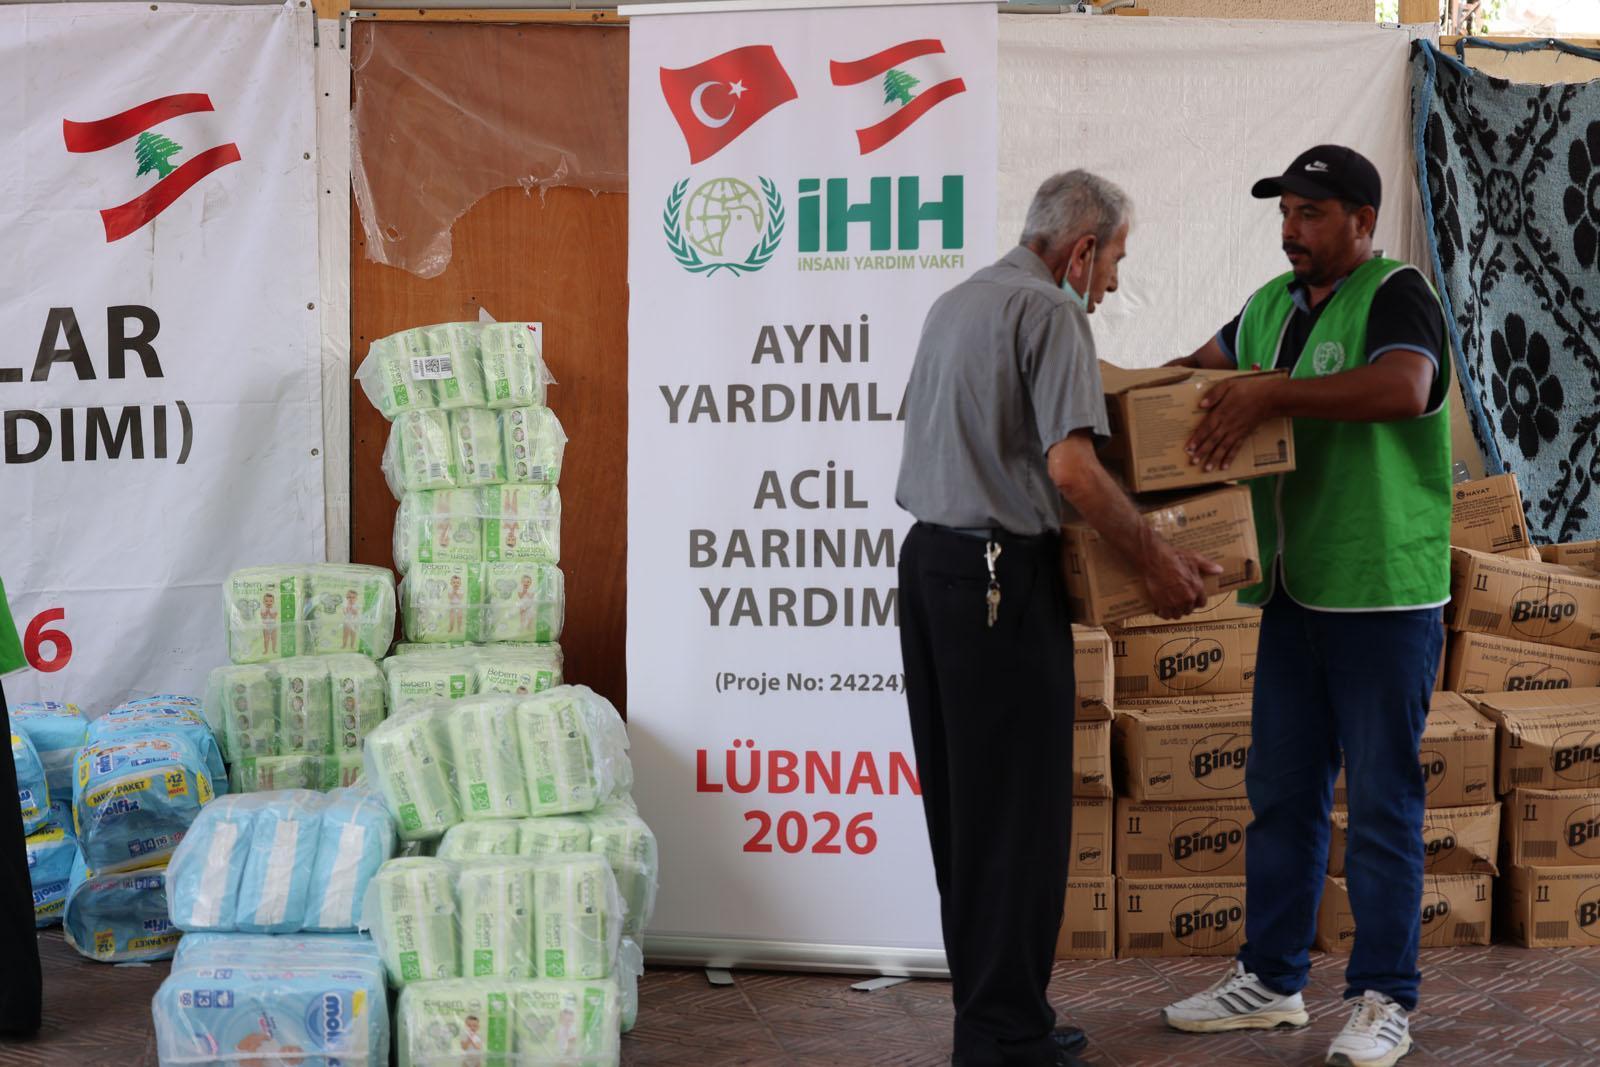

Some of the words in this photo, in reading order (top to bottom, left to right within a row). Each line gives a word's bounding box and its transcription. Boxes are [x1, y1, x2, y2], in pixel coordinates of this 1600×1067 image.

[854, 256, 915, 271] YARDIM
[919, 255, 964, 269] VAKFI
[751, 314, 870, 364] AYNİ
[753, 460, 868, 509] ACİL
[1466, 488, 1490, 496] HAYAT
[689, 528, 898, 568] BARINM
[1479, 563, 1496, 572] BINGO
[1512, 600, 1575, 623] Bingo
[1248, 620, 1260, 629] ADE
[487, 668, 518, 679] Bebem
[1160, 648, 1222, 681] Bingo
[715, 672, 780, 695] (Proje
[787, 674, 824, 692] No:
[829, 673, 906, 695] 24224)
[1231, 720, 1251, 728] DETER
[696, 739, 923, 795] LÜBNAN
[1194, 746, 1247, 779] Bing
[1554, 744, 1600, 772] Bing
[117, 780, 145, 793] PAKET
[1150, 773, 1171, 786] Bingo
[743, 810, 877, 855] 2026
[1568, 820, 1600, 848] Bin
[1174, 829, 1242, 861] Bingo
[144, 919, 174, 932] olfix
[1175, 906, 1242, 938] Bingo
[135, 938, 161, 948] PAKET
